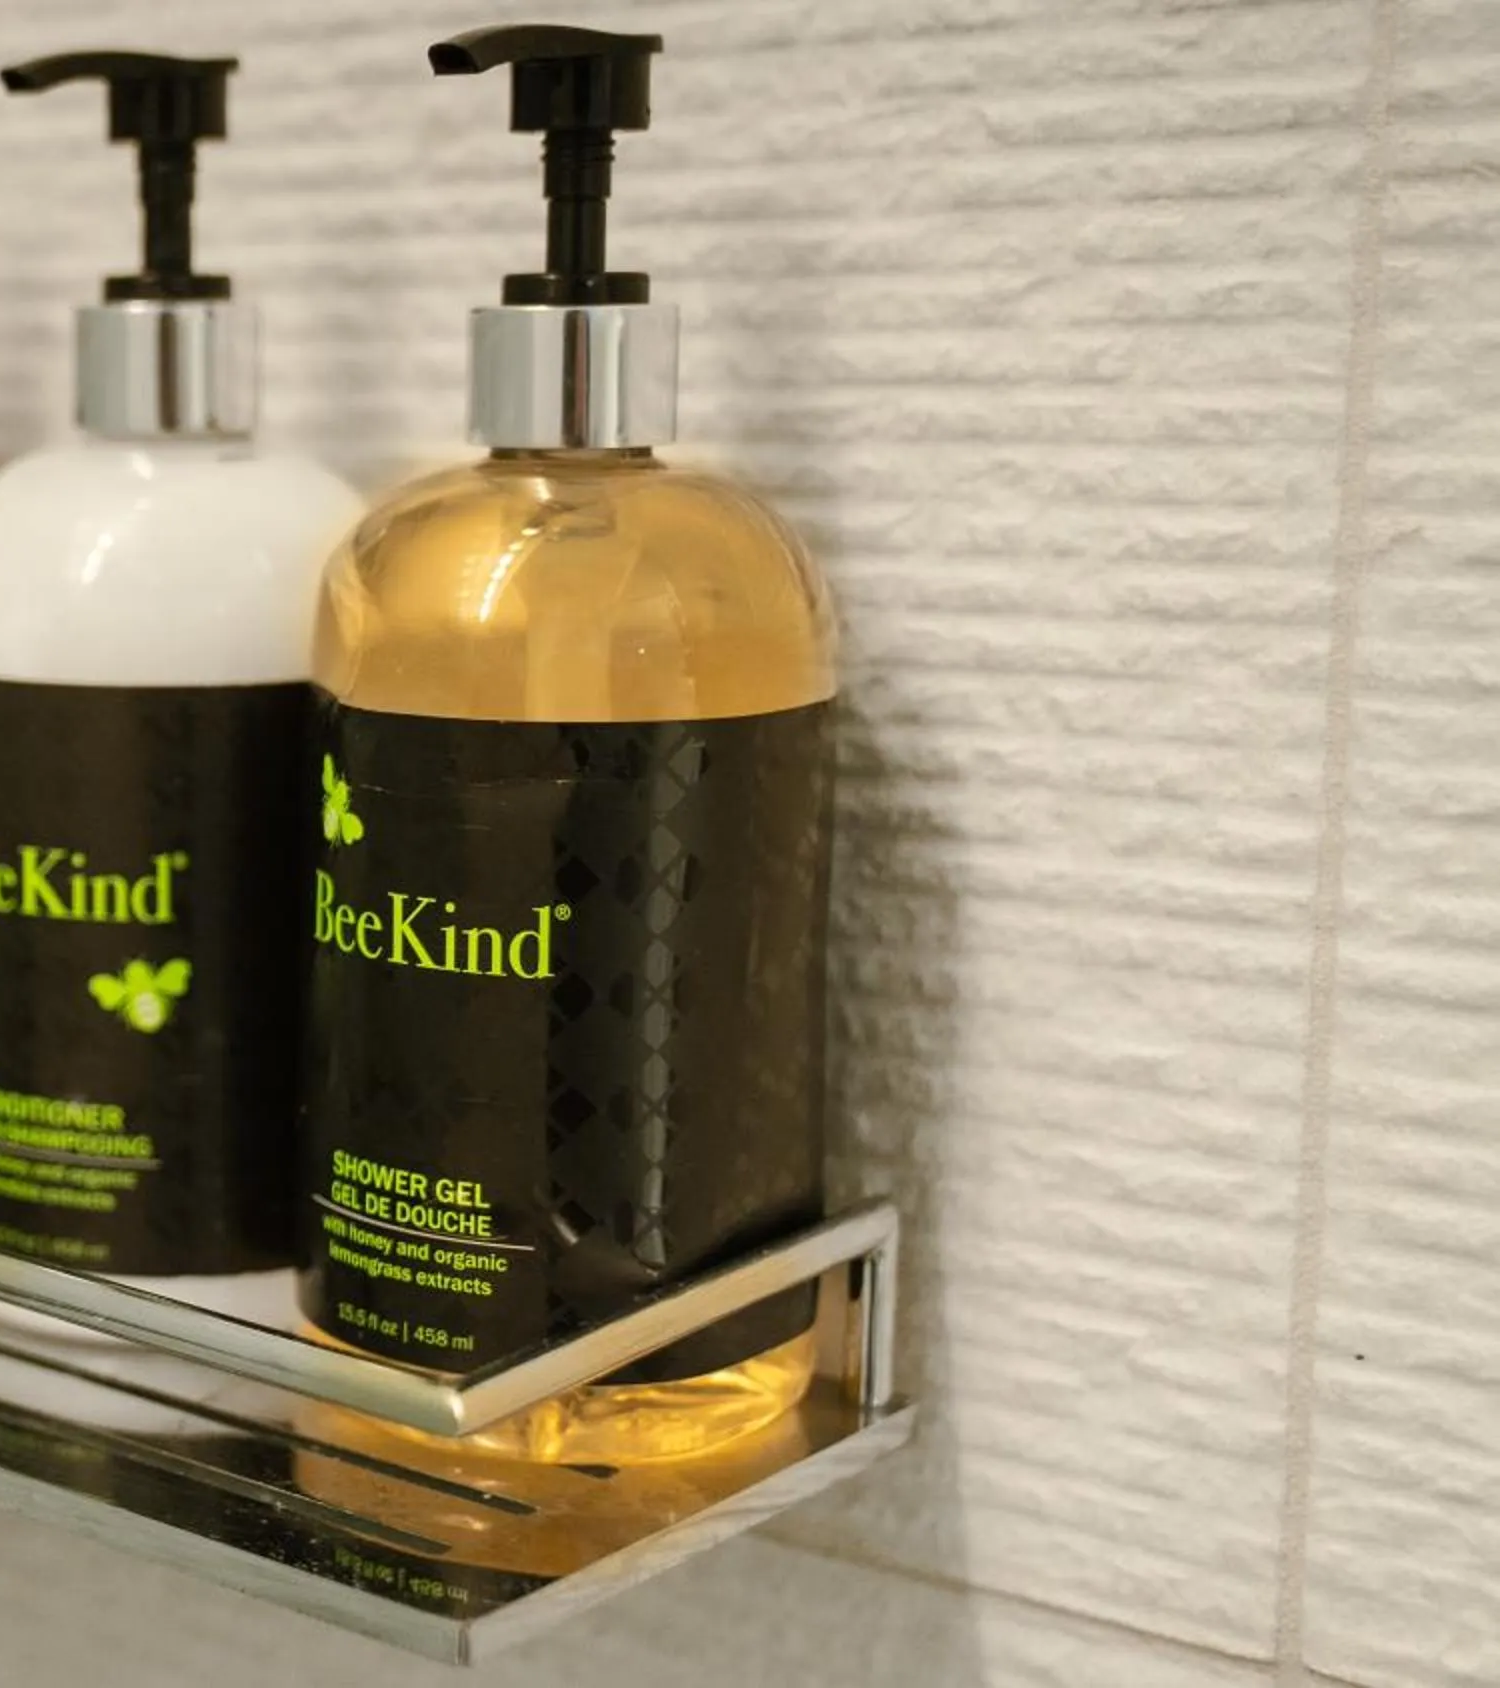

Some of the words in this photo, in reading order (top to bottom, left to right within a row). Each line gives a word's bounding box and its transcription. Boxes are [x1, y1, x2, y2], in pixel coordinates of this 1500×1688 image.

[331, 1180, 361, 1211] GEL
[365, 1192, 392, 1219] DE
[396, 1201, 493, 1237] DOUCHE
[332, 1150, 428, 1199] SHOWER
[435, 1179, 492, 1209] GEL
[322, 1214, 347, 1237] with
[349, 1223, 393, 1255] honey
[396, 1240, 431, 1261] and
[434, 1249, 509, 1273] organic
[328, 1238, 413, 1283] lemongrass
[415, 1270, 494, 1296] extracts
[380, 1319, 398, 1336] oz
[414, 1325, 449, 1347] 458
[451, 1335, 475, 1352] ml
